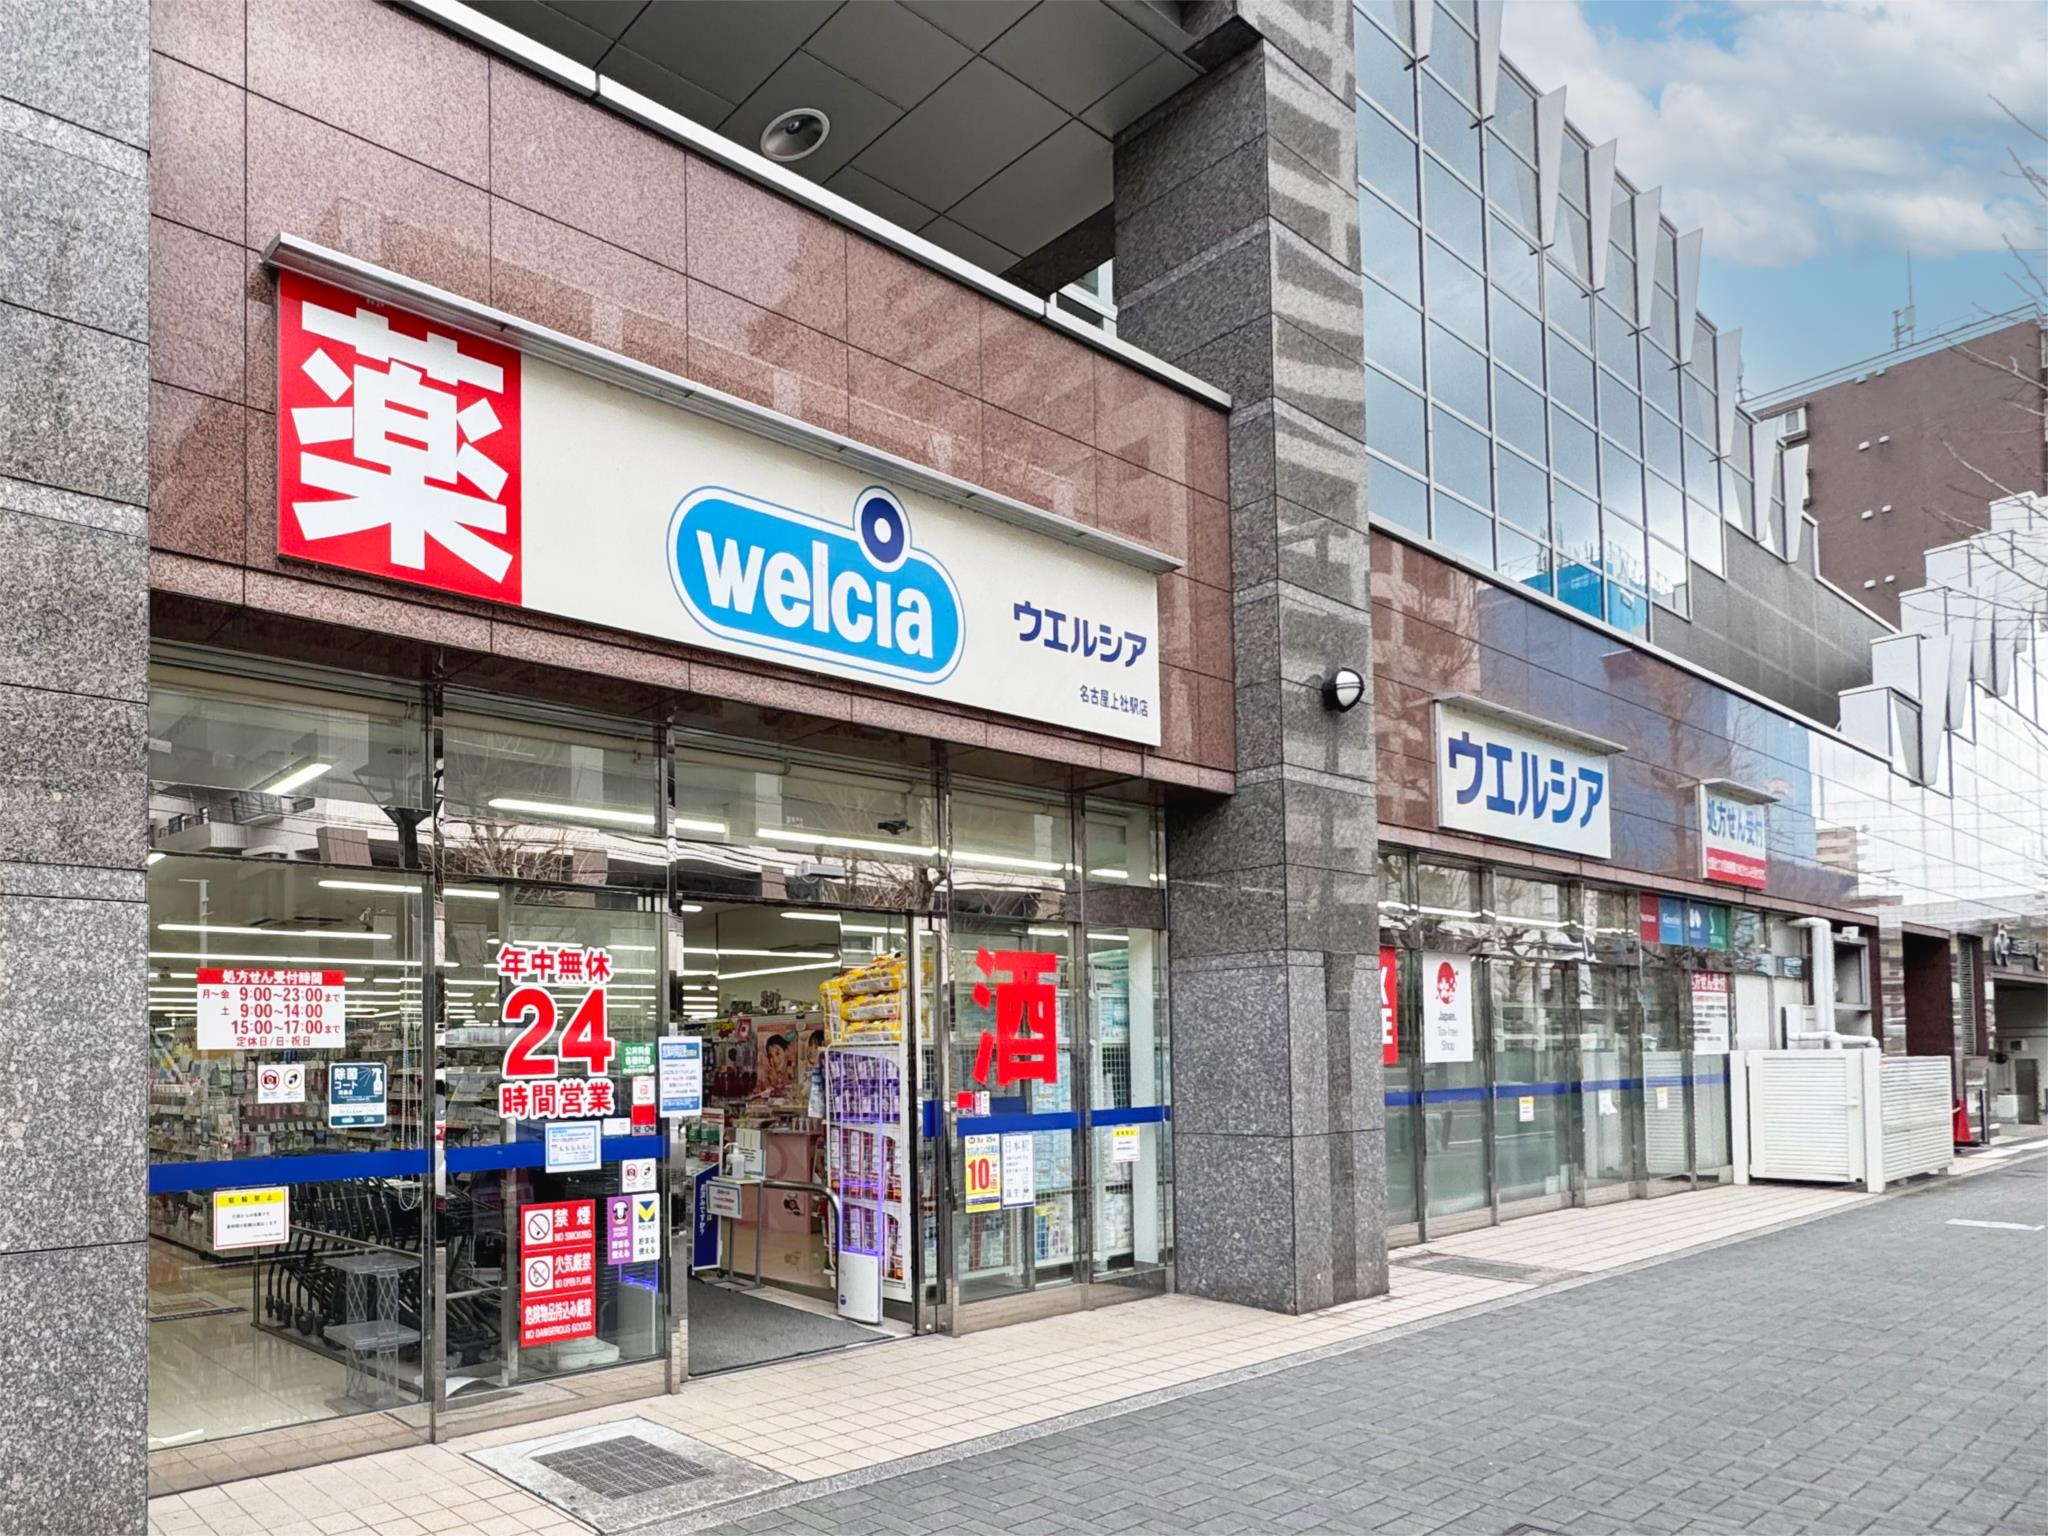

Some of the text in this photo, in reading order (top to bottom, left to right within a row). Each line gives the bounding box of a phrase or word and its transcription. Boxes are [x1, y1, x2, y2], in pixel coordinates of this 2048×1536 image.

[291, 300, 513, 584] 薬
[696, 497, 934, 660] welcia
[1013, 600, 1147, 668] ウエルシア
[1079, 684, 1149, 718] 名古屋上社駅店
[1448, 731, 1604, 829] ウエルシア
[221, 969, 323, 986] 処方せん受付時間
[498, 945, 613, 982] 年中無休
[220, 1006, 230, 1016] 土
[972, 946, 1058, 1086] 酒
[504, 986, 613, 1077] 24
[334, 1067, 359, 1080] 除菌
[334, 1080, 359, 1090] コート
[501, 1080, 613, 1118] 時間営業
[967, 1157, 990, 1191] 10
[554, 1205, 591, 1228] 禁煙
[554, 1229, 592, 1242] NO SMOKING
[554, 1252, 592, 1275] 火気厳禁
[554, 1279, 563, 1288] NO
[525, 1321, 592, 1340] NO DANGEROUS GOODS
